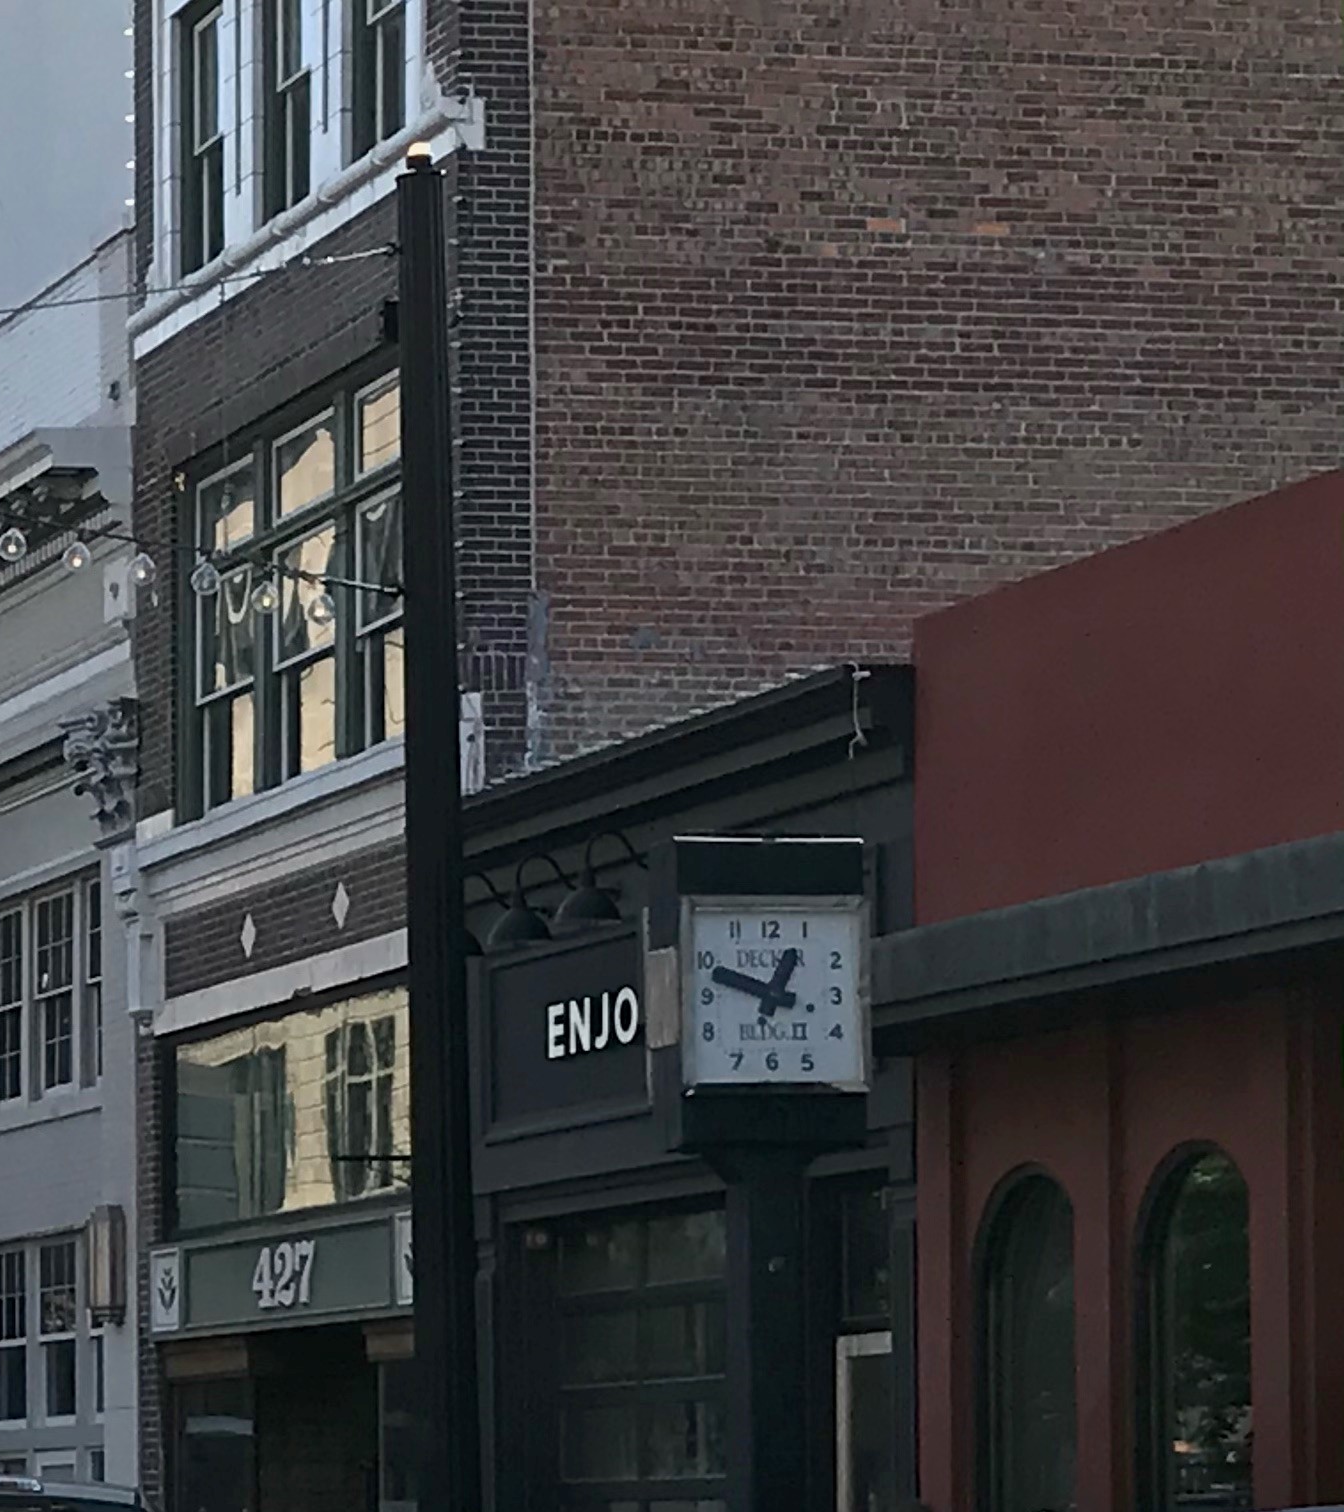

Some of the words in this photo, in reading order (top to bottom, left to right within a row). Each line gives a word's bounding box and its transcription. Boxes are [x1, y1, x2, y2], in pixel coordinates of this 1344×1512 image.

[729, 920, 741, 939] 11
[761, 920, 781, 939] 12
[802, 920, 808, 939] 1
[697, 951, 715, 970] 10
[736, 948, 806, 968] DECKR
[829, 951, 843, 970] 2
[701, 987, 714, 1006] 9
[829, 986, 843, 1005] 3
[702, 1022, 715, 1042] 8
[828, 1023, 844, 1040] 4
[729, 1053, 744, 1071] 7
[765, 1052, 779, 1072] 6
[800, 1053, 815, 1072] 5
[251, 1239, 316, 1311] 427
